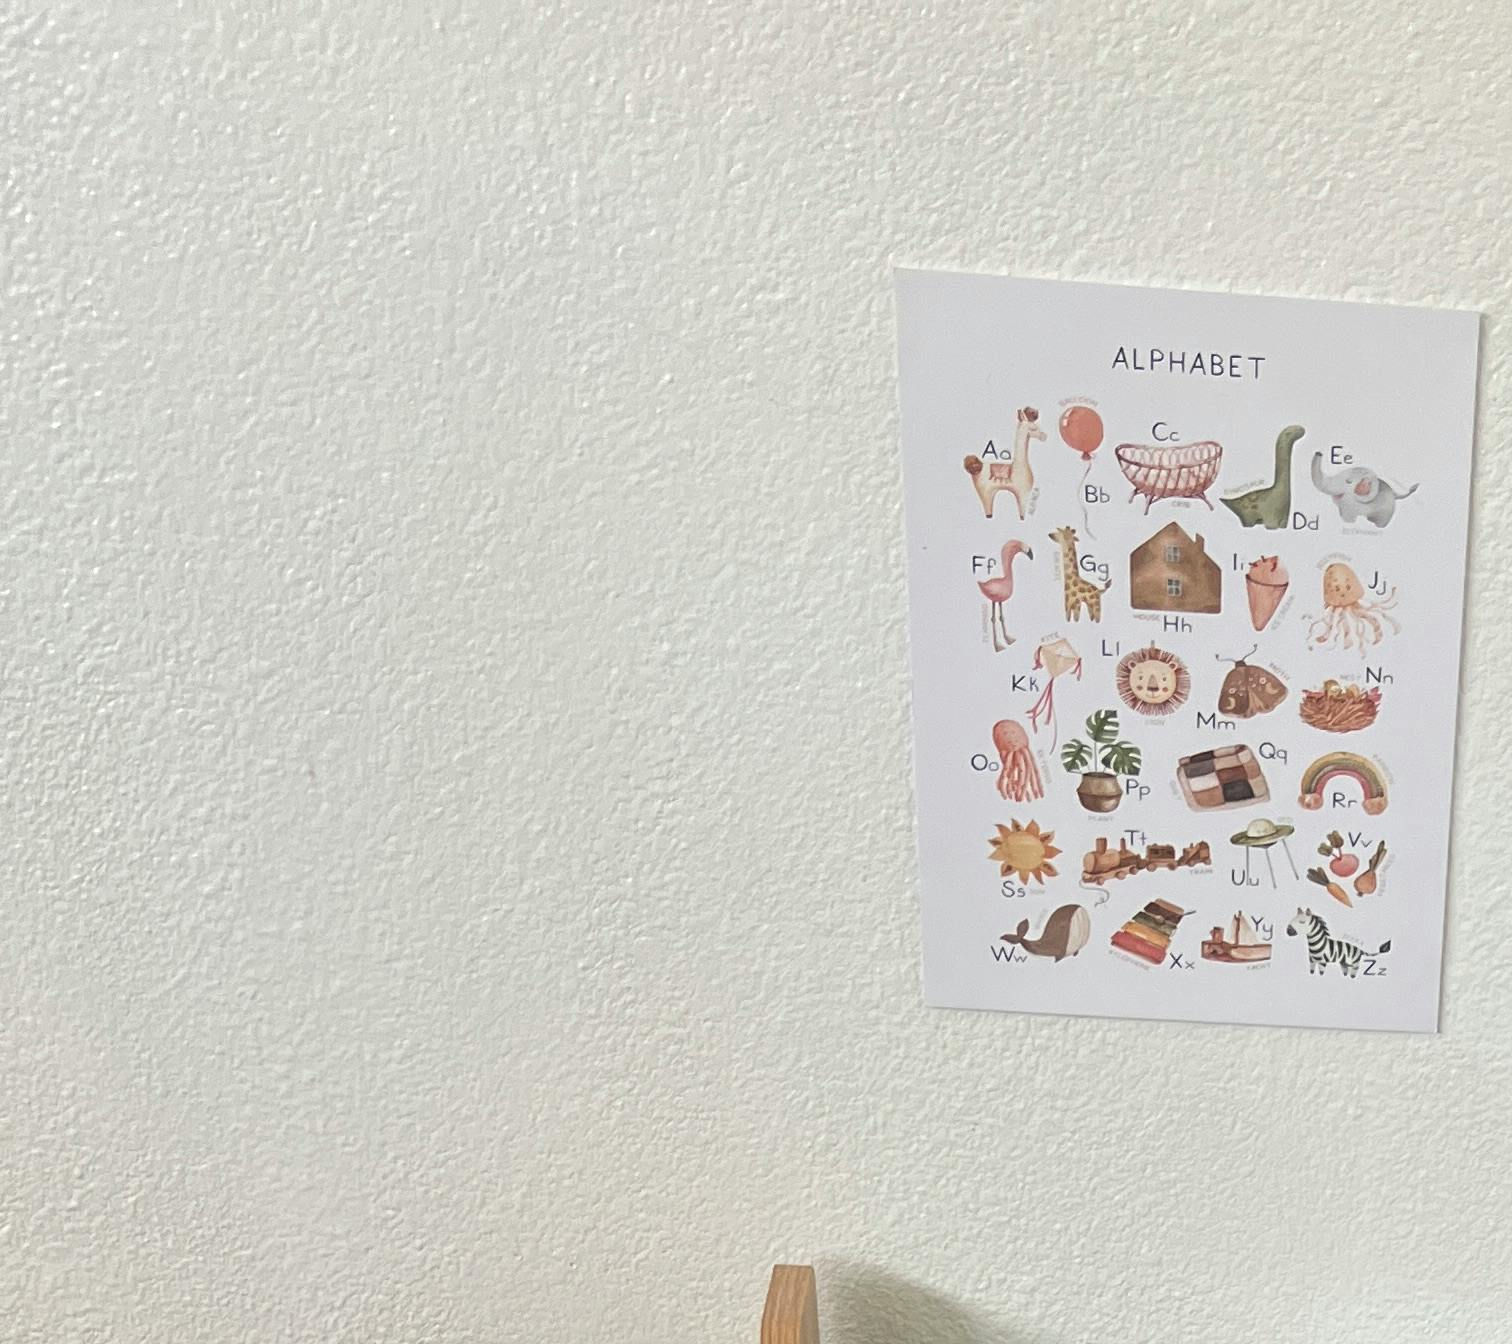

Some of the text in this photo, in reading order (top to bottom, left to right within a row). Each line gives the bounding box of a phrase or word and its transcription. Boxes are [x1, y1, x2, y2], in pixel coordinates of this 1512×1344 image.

[1111, 345, 1266, 380] ALPHABET
[1152, 422, 1180, 442] Cc
[981, 440, 1012, 460] Aa
[1331, 446, 1353, 465] Ee
[1084, 484, 1111, 503] Bb
[1292, 511, 1319, 531] Dd
[972, 555, 997, 575] Ff
[1079, 554, 1110, 581] Gg
[1368, 570, 1387, 596] Jj
[1163, 615, 1193, 634] Hh
[1012, 674, 1040, 692] Kk
[1366, 666, 1394, 685] Nn
[1196, 711, 1236, 731] Mm
[970, 753, 999, 772] Oo
[1259, 742, 1288, 764] Qq
[1125, 778, 1151, 801] Pp
[1332, 792, 1358, 809] Rr
[1124, 829, 1148, 846] Tt
[1348, 832, 1373, 848] Vv
[1231, 869, 1260, 887] Uu
[1001, 880, 1026, 898] Ss
[1250, 916, 1274, 941] Yy
[990, 945, 1028, 963] Ww
[1169, 952, 1196, 970] Xx
[1363, 959, 1388, 977] Zz
